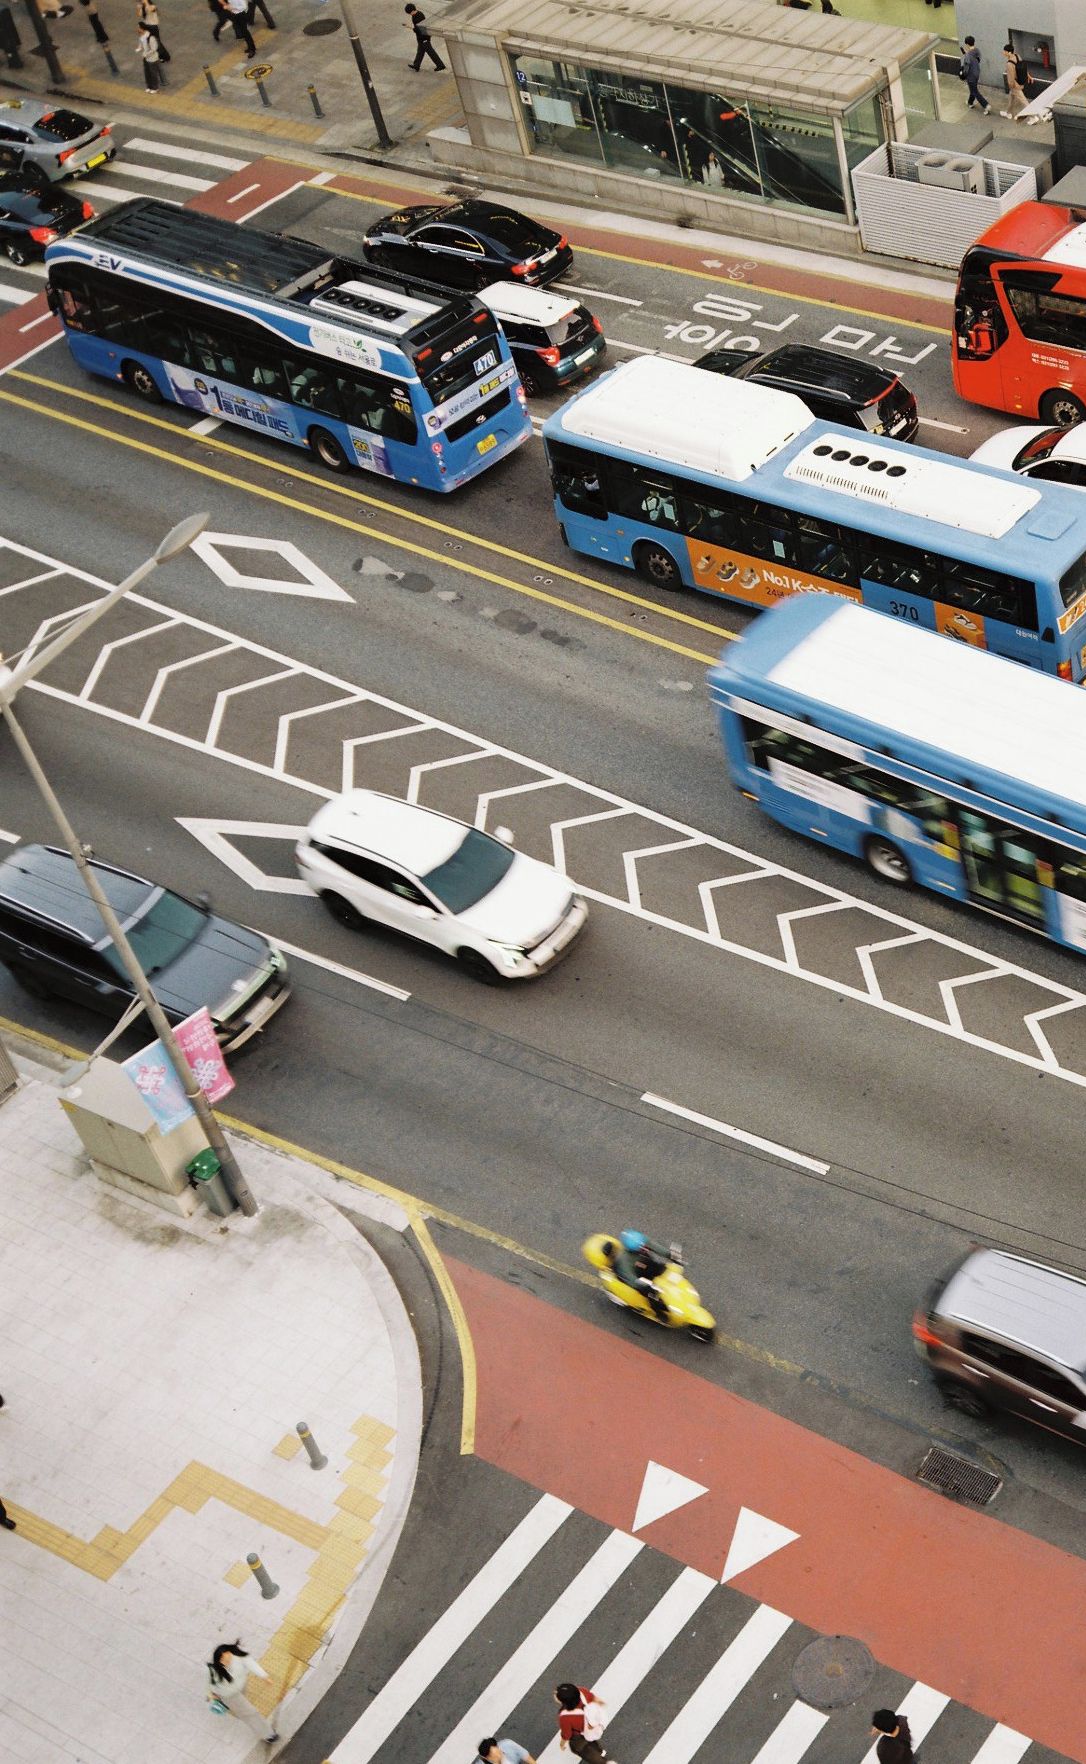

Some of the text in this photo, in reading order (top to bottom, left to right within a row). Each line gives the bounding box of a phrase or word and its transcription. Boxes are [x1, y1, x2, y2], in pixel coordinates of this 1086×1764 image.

[516, 71, 526, 82] 12
[95, 255, 121, 270] EV
[476, 350, 496, 374] 470
[393, 400, 411, 413] 470
[762, 570, 790, 589] No.1
[889, 601, 919, 621] 370
